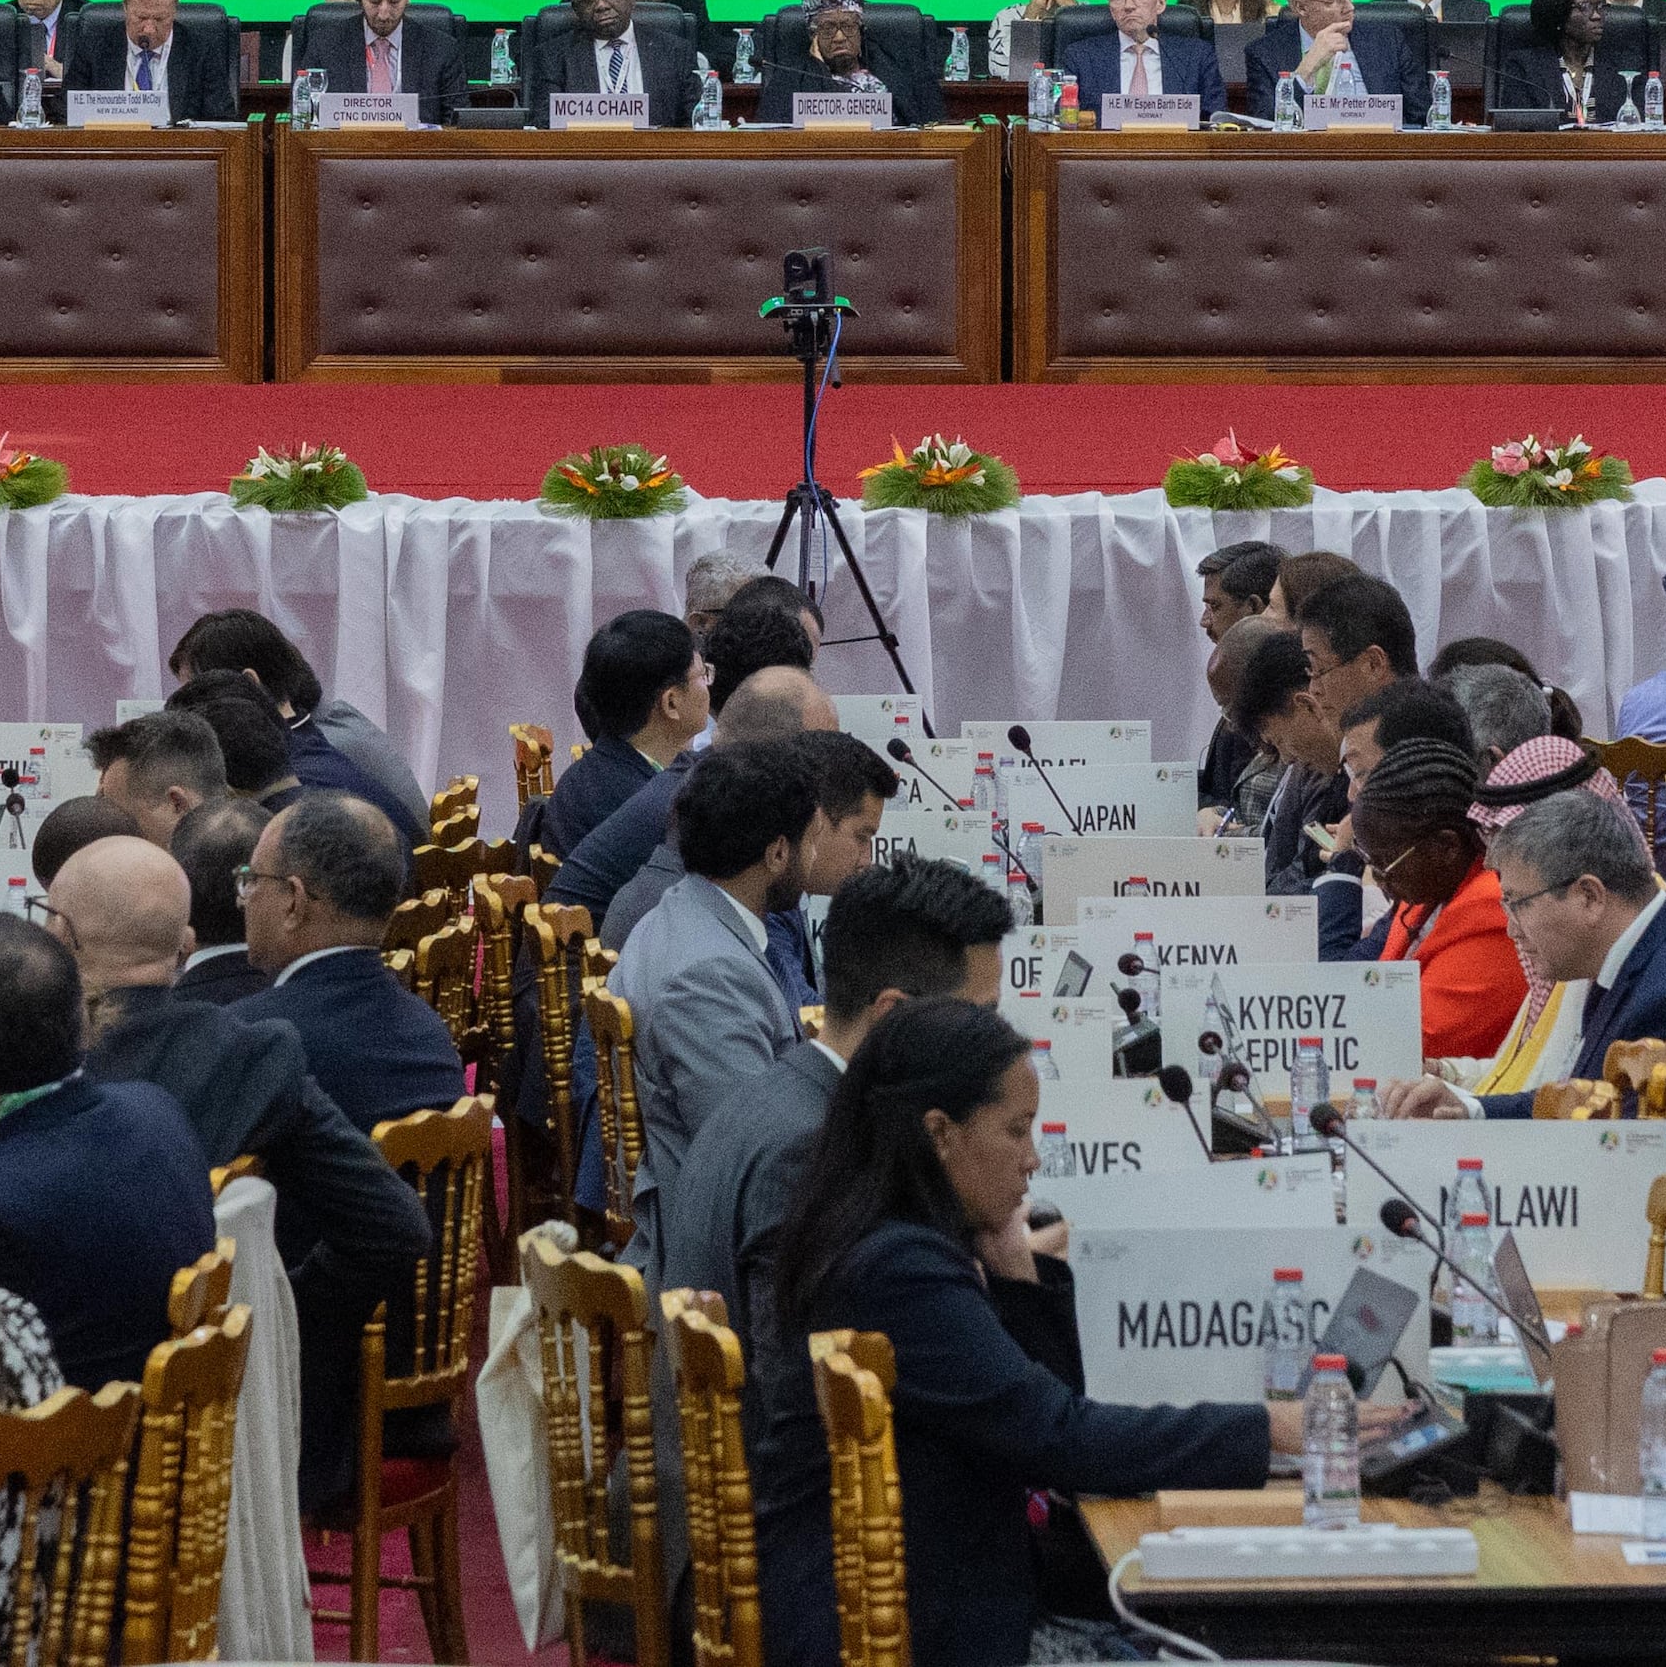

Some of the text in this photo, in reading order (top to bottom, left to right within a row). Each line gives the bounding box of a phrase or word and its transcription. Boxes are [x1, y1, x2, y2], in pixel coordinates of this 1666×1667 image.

[343, 98, 392, 108] DIRECTOR
[555, 100, 643, 115] MC14 CHAIR
[1108, 98, 1122, 109] H.E.
[1123, 98, 1134, 109] Mr
[1134, 98, 1156, 111] Espen
[1157, 99, 1176, 110] Barth
[1312, 98, 1327, 108] H.E.
[1330, 98, 1340, 108] Mr
[1342, 97, 1366, 108] Petter
[332, 112, 403, 122] CTNC DIVISION
[1075, 804, 1136, 833] JAPAN
[1240, 995, 1346, 1030] KYRGYZ
